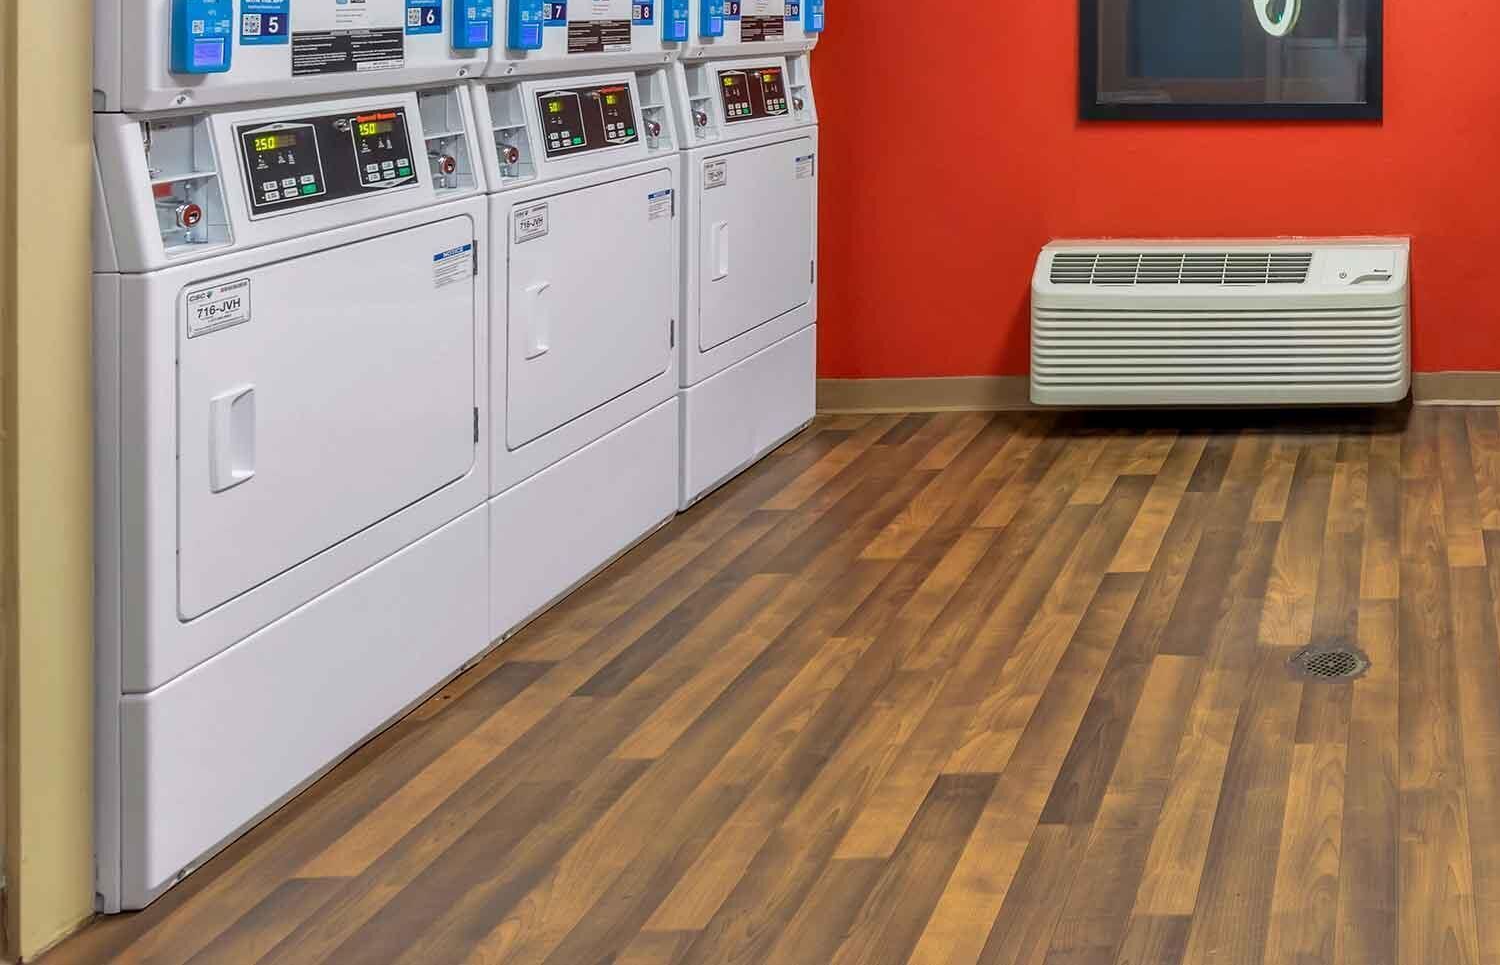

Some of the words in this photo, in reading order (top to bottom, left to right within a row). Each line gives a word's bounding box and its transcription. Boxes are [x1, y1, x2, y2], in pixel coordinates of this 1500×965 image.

[555, 5, 562, 19] 7
[643, 6, 650, 19] 8
[732, 3, 738, 15] 9
[791, 5, 799, 14] 10
[426, 9, 435, 24] 6
[268, 16, 279, 34] 5
[197, 297, 241, 319] 716-JVH
